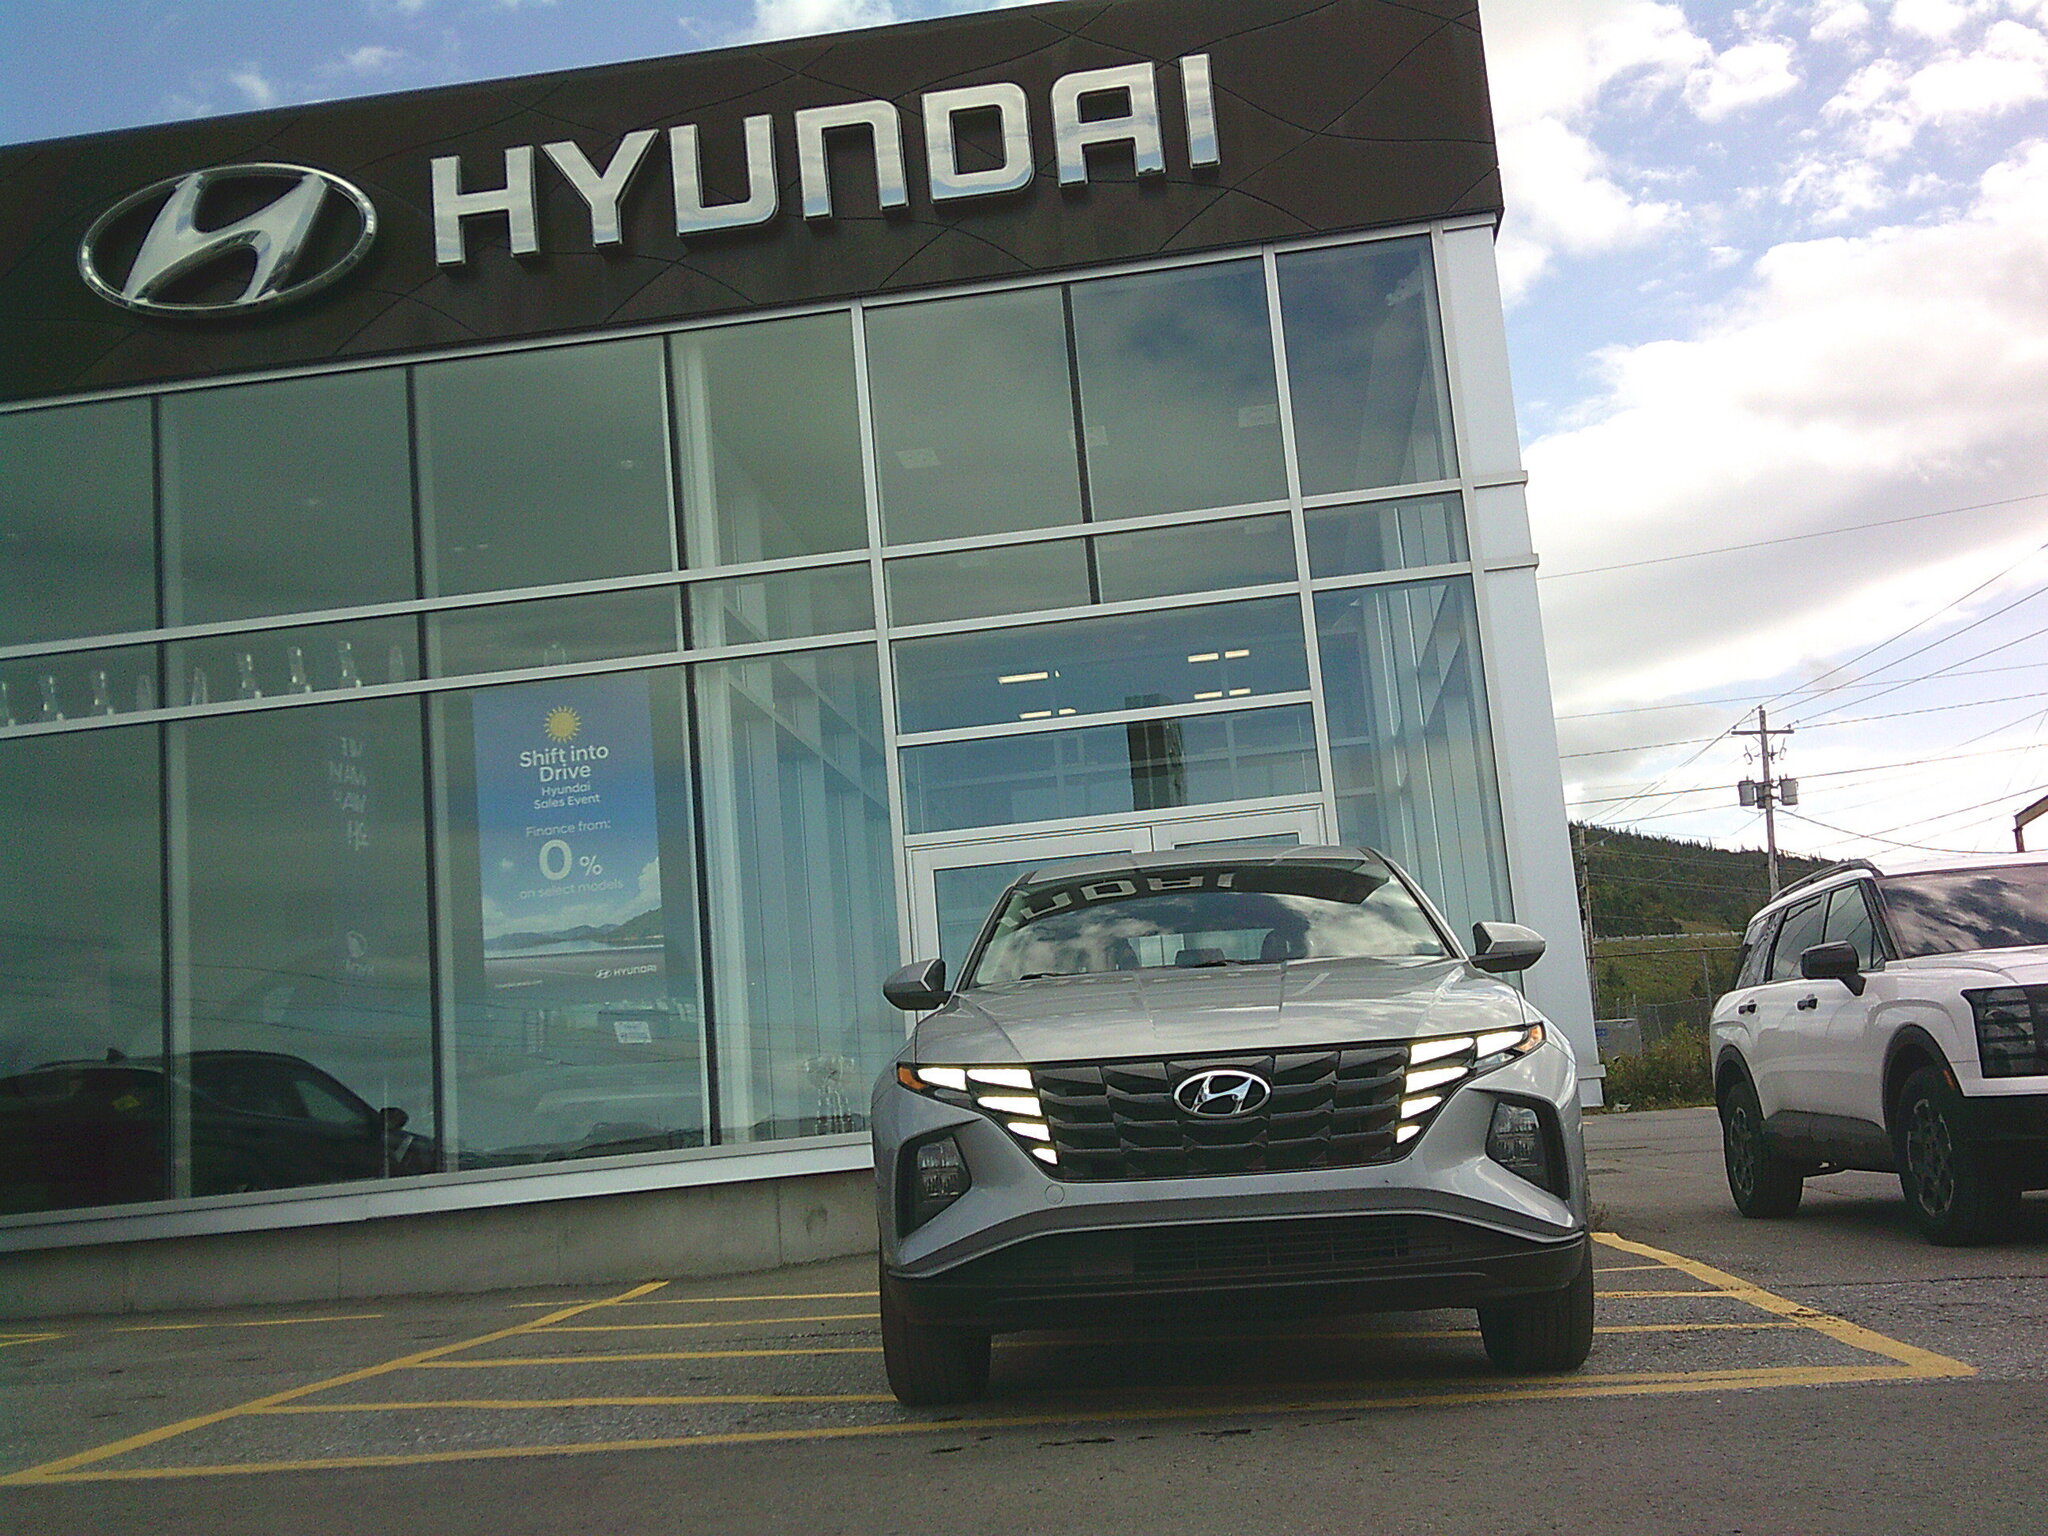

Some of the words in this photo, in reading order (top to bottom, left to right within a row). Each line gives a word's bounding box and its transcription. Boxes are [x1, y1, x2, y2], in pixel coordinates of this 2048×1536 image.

[431, 53, 1221, 266] HYUNDAI
[519, 747, 566, 768] Shift
[570, 745, 609, 761] into
[540, 763, 592, 782] Drive
[541, 781, 591, 797] Hyundai
[534, 798, 565, 809] Sales
[567, 794, 600, 806] Event
[526, 824, 576, 837] Finance
[578, 819, 612, 832] from:
[539, 839, 572, 880] 0
[519, 889, 536, 900] on
[538, 882, 576, 897] select
[578, 878, 625, 893] models
[613, 964, 657, 977] HYUNDAI
